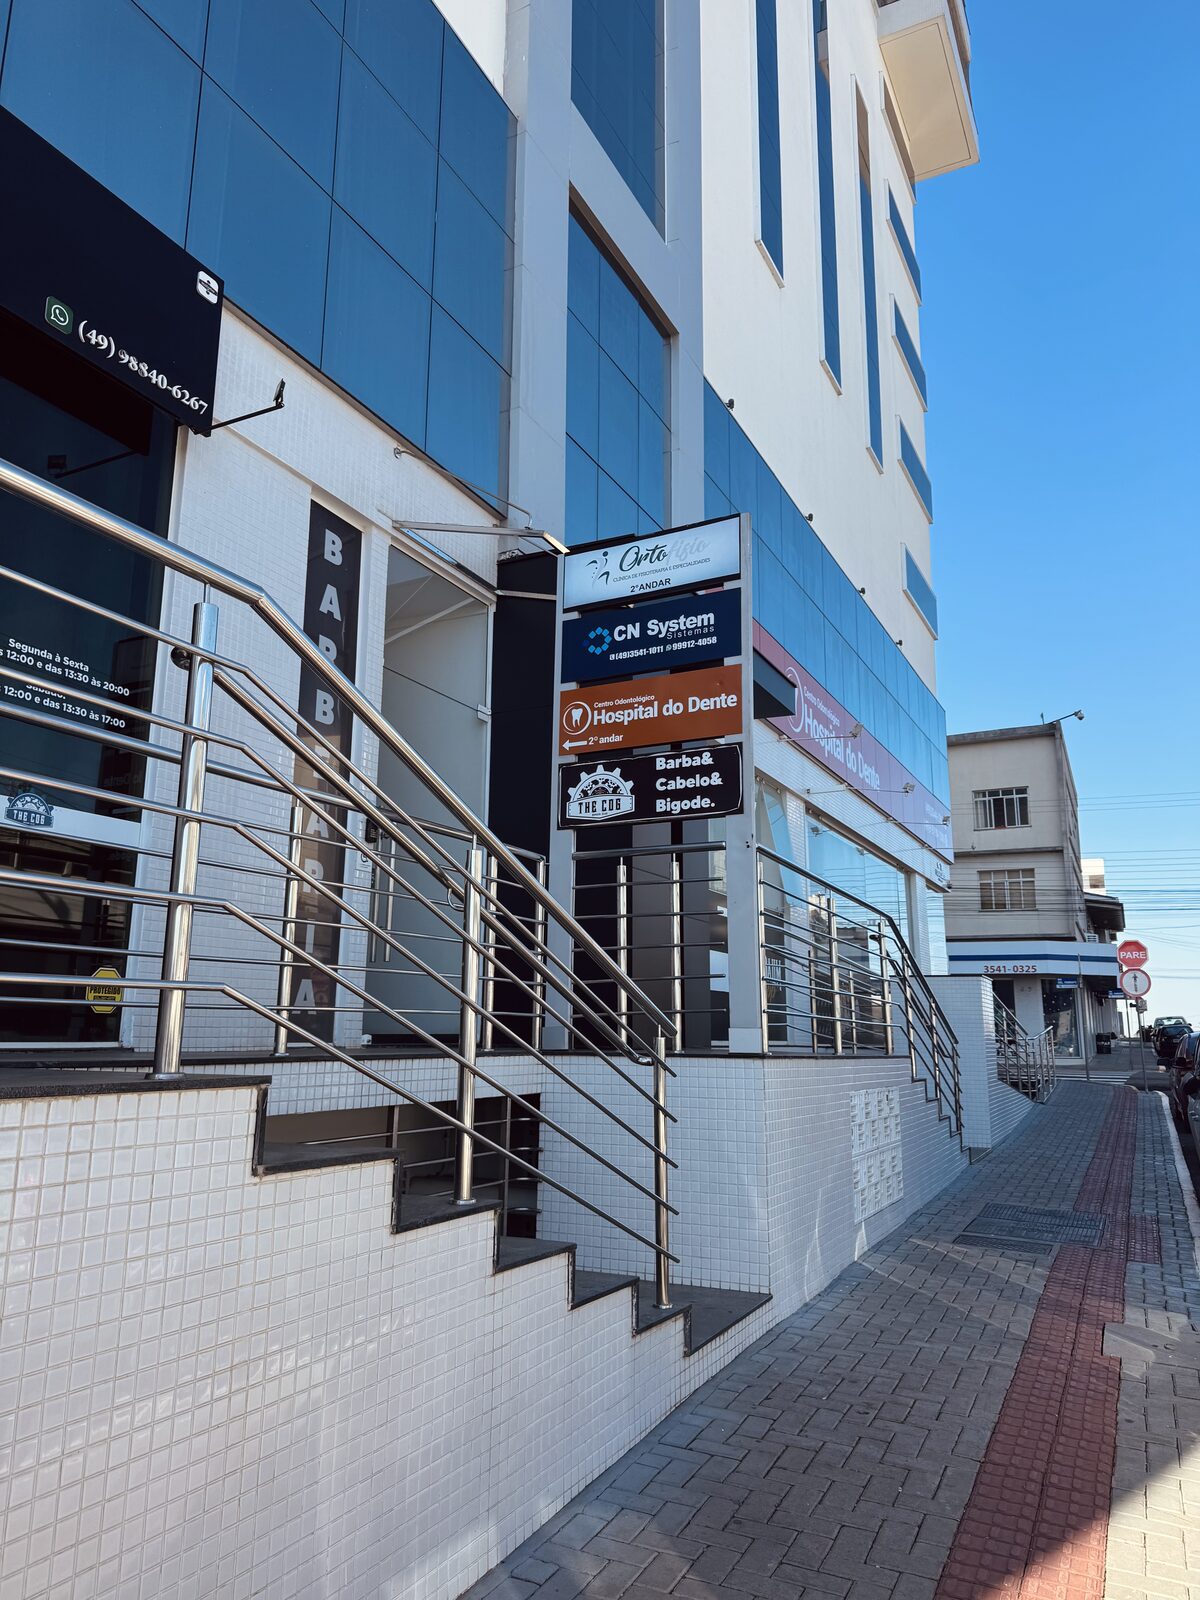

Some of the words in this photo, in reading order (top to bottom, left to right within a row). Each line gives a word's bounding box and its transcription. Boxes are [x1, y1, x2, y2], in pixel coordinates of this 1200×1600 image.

[78, 320, 116, 359] (49)
[118, 349, 209, 415] 98840-6267
[638, 566, 669, 577] FISIOTERAPIA
[672, 557, 711, 570] ESPECIALIDADES
[613, 622, 641, 642] CN
[646, 612, 715, 639] System
[666, 625, 715, 640] Sistemas
[672, 636, 718, 651] 99912-4058
[8, 638, 53, 660] Segunda
[54, 653, 61, 663] à
[62, 656, 90, 672] Sexta
[6, 649, 35, 666] 12:00
[36, 661, 43, 669] e
[44, 663, 63, 675] das
[64, 669, 89, 683] 13:30
[90, 676, 102, 687] às
[103, 681, 130, 697] 20:00
[4, 685, 32, 701] 12:00
[34, 696, 41, 704] e
[42, 697, 60, 710] das
[62, 702, 88, 717] 13:30
[89, 710, 100, 721] às
[101, 714, 126, 729] 17:00
[592, 701, 659, 726] Hospital
[662, 699, 684, 716] do
[688, 693, 738, 713] Dente
[593, 700, 614, 709] Centro
[614, 694, 655, 707] Odontológico
[599, 733, 624, 744] andar
[804, 703, 845, 764] Hospital
[845, 741, 857, 773] do
[858, 752, 880, 790] Dente
[655, 752, 715, 771] Barba&
[655, 772, 723, 792] Cabelo&
[578, 800, 597, 815] THE
[601, 798, 621, 812] COG
[655, 796, 716, 814] Bigode.
[13, 809, 28, 822] THE
[1120, 951, 1146, 959] PARE
[983, 965, 1037, 973] 3541-0325
